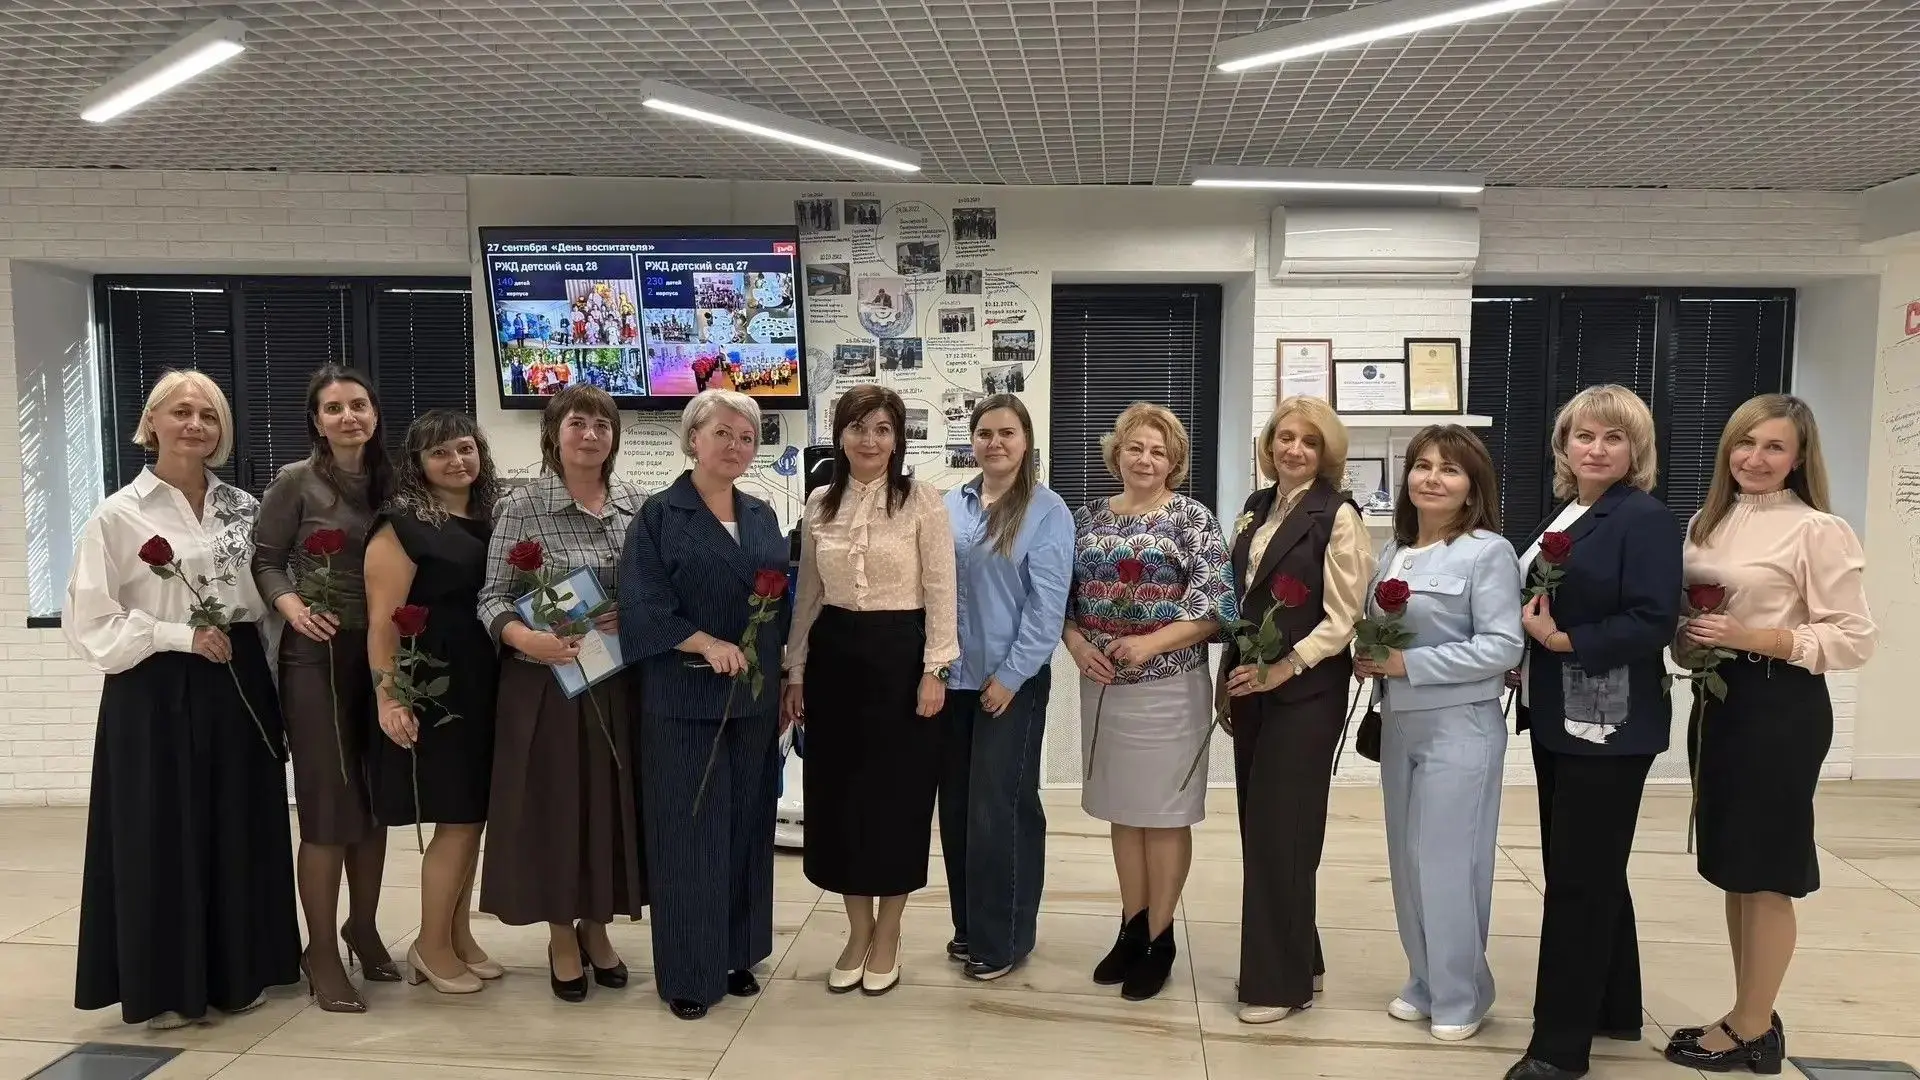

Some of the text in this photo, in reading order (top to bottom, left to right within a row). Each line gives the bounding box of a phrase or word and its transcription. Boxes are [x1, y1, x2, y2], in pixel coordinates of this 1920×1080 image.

[487, 243, 655, 253] 27 сентября «День воспитателя»
[495, 261, 598, 272] РЖД детский сад 28
[645, 261, 748, 272] РЖД детский сад 27
[497, 277, 514, 286] 140
[647, 277, 663, 285] 230
[498, 288, 504, 296] 2
